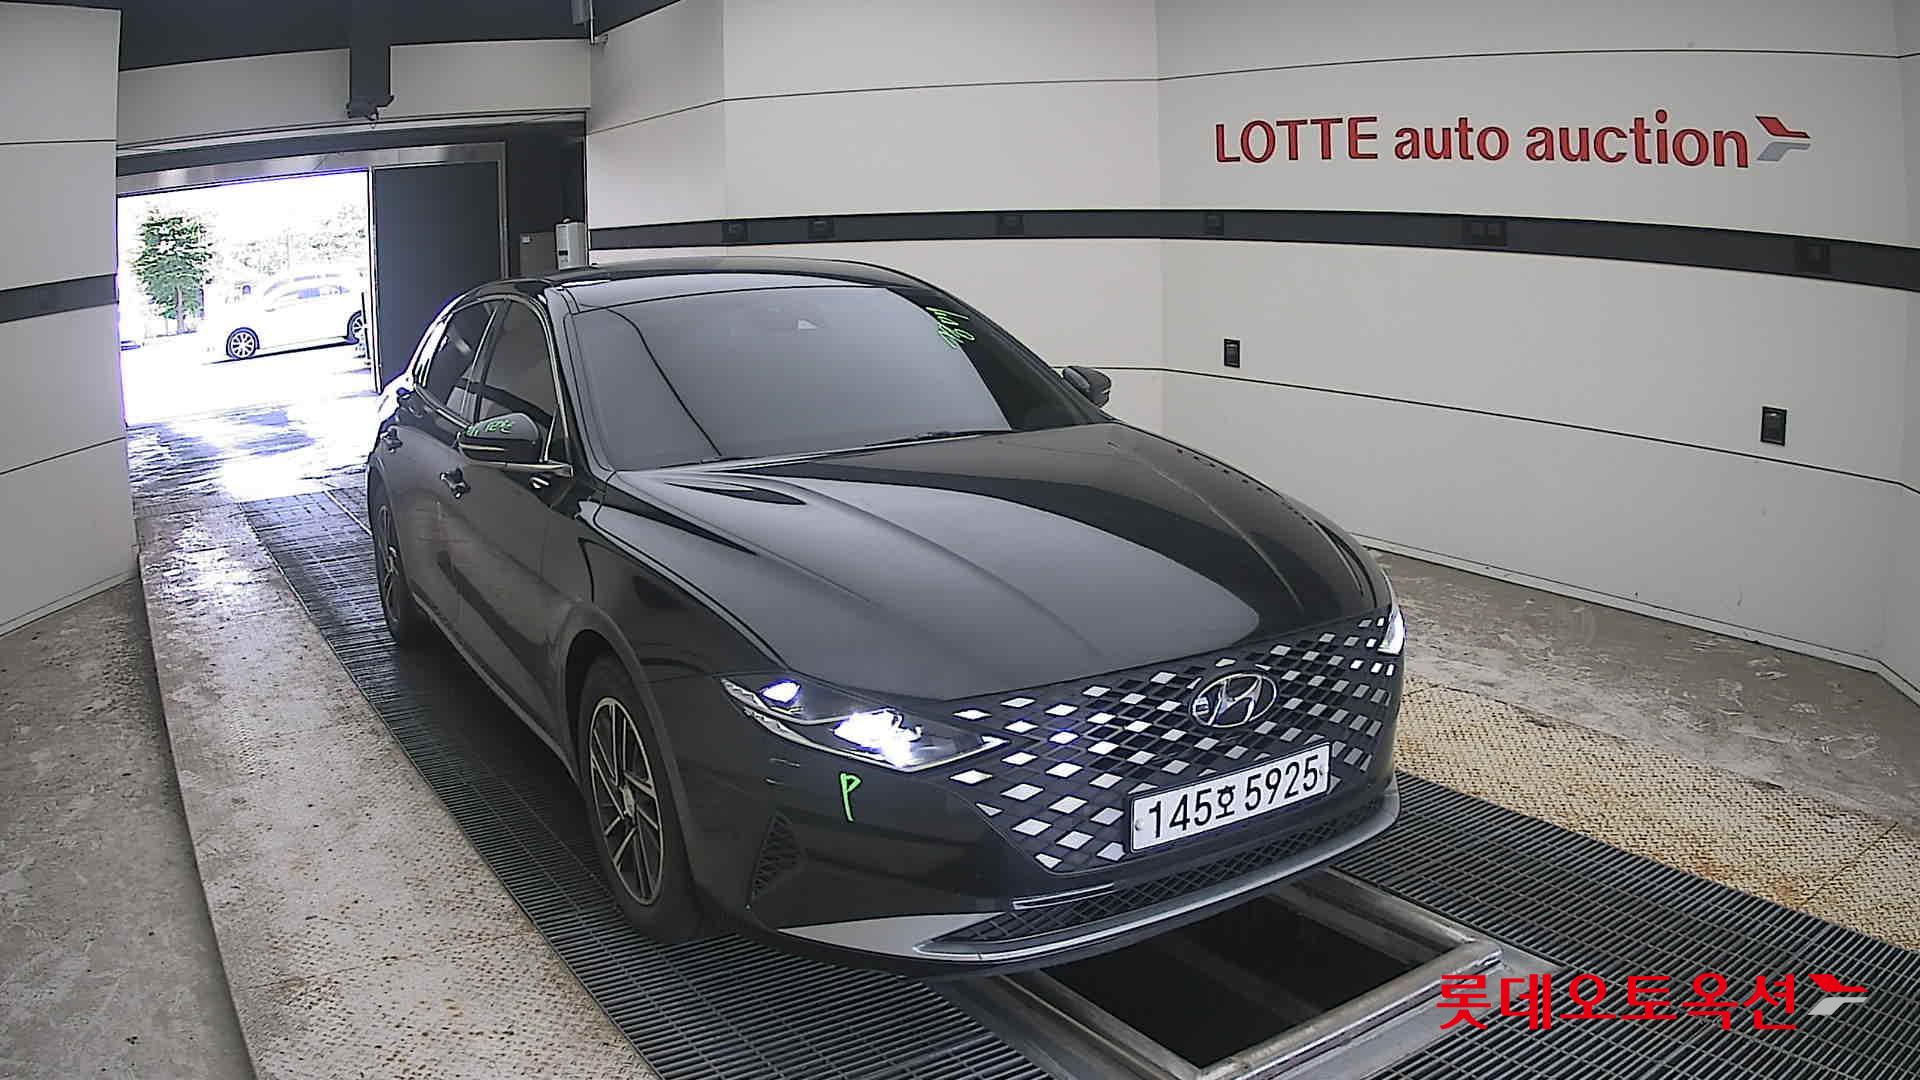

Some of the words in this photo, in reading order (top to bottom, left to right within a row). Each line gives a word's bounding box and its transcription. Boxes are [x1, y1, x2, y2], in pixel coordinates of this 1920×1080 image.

[1214, 115, 1379, 163] LOTTE
[1393, 115, 1510, 162] auto
[1525, 109, 1750, 169] auction
